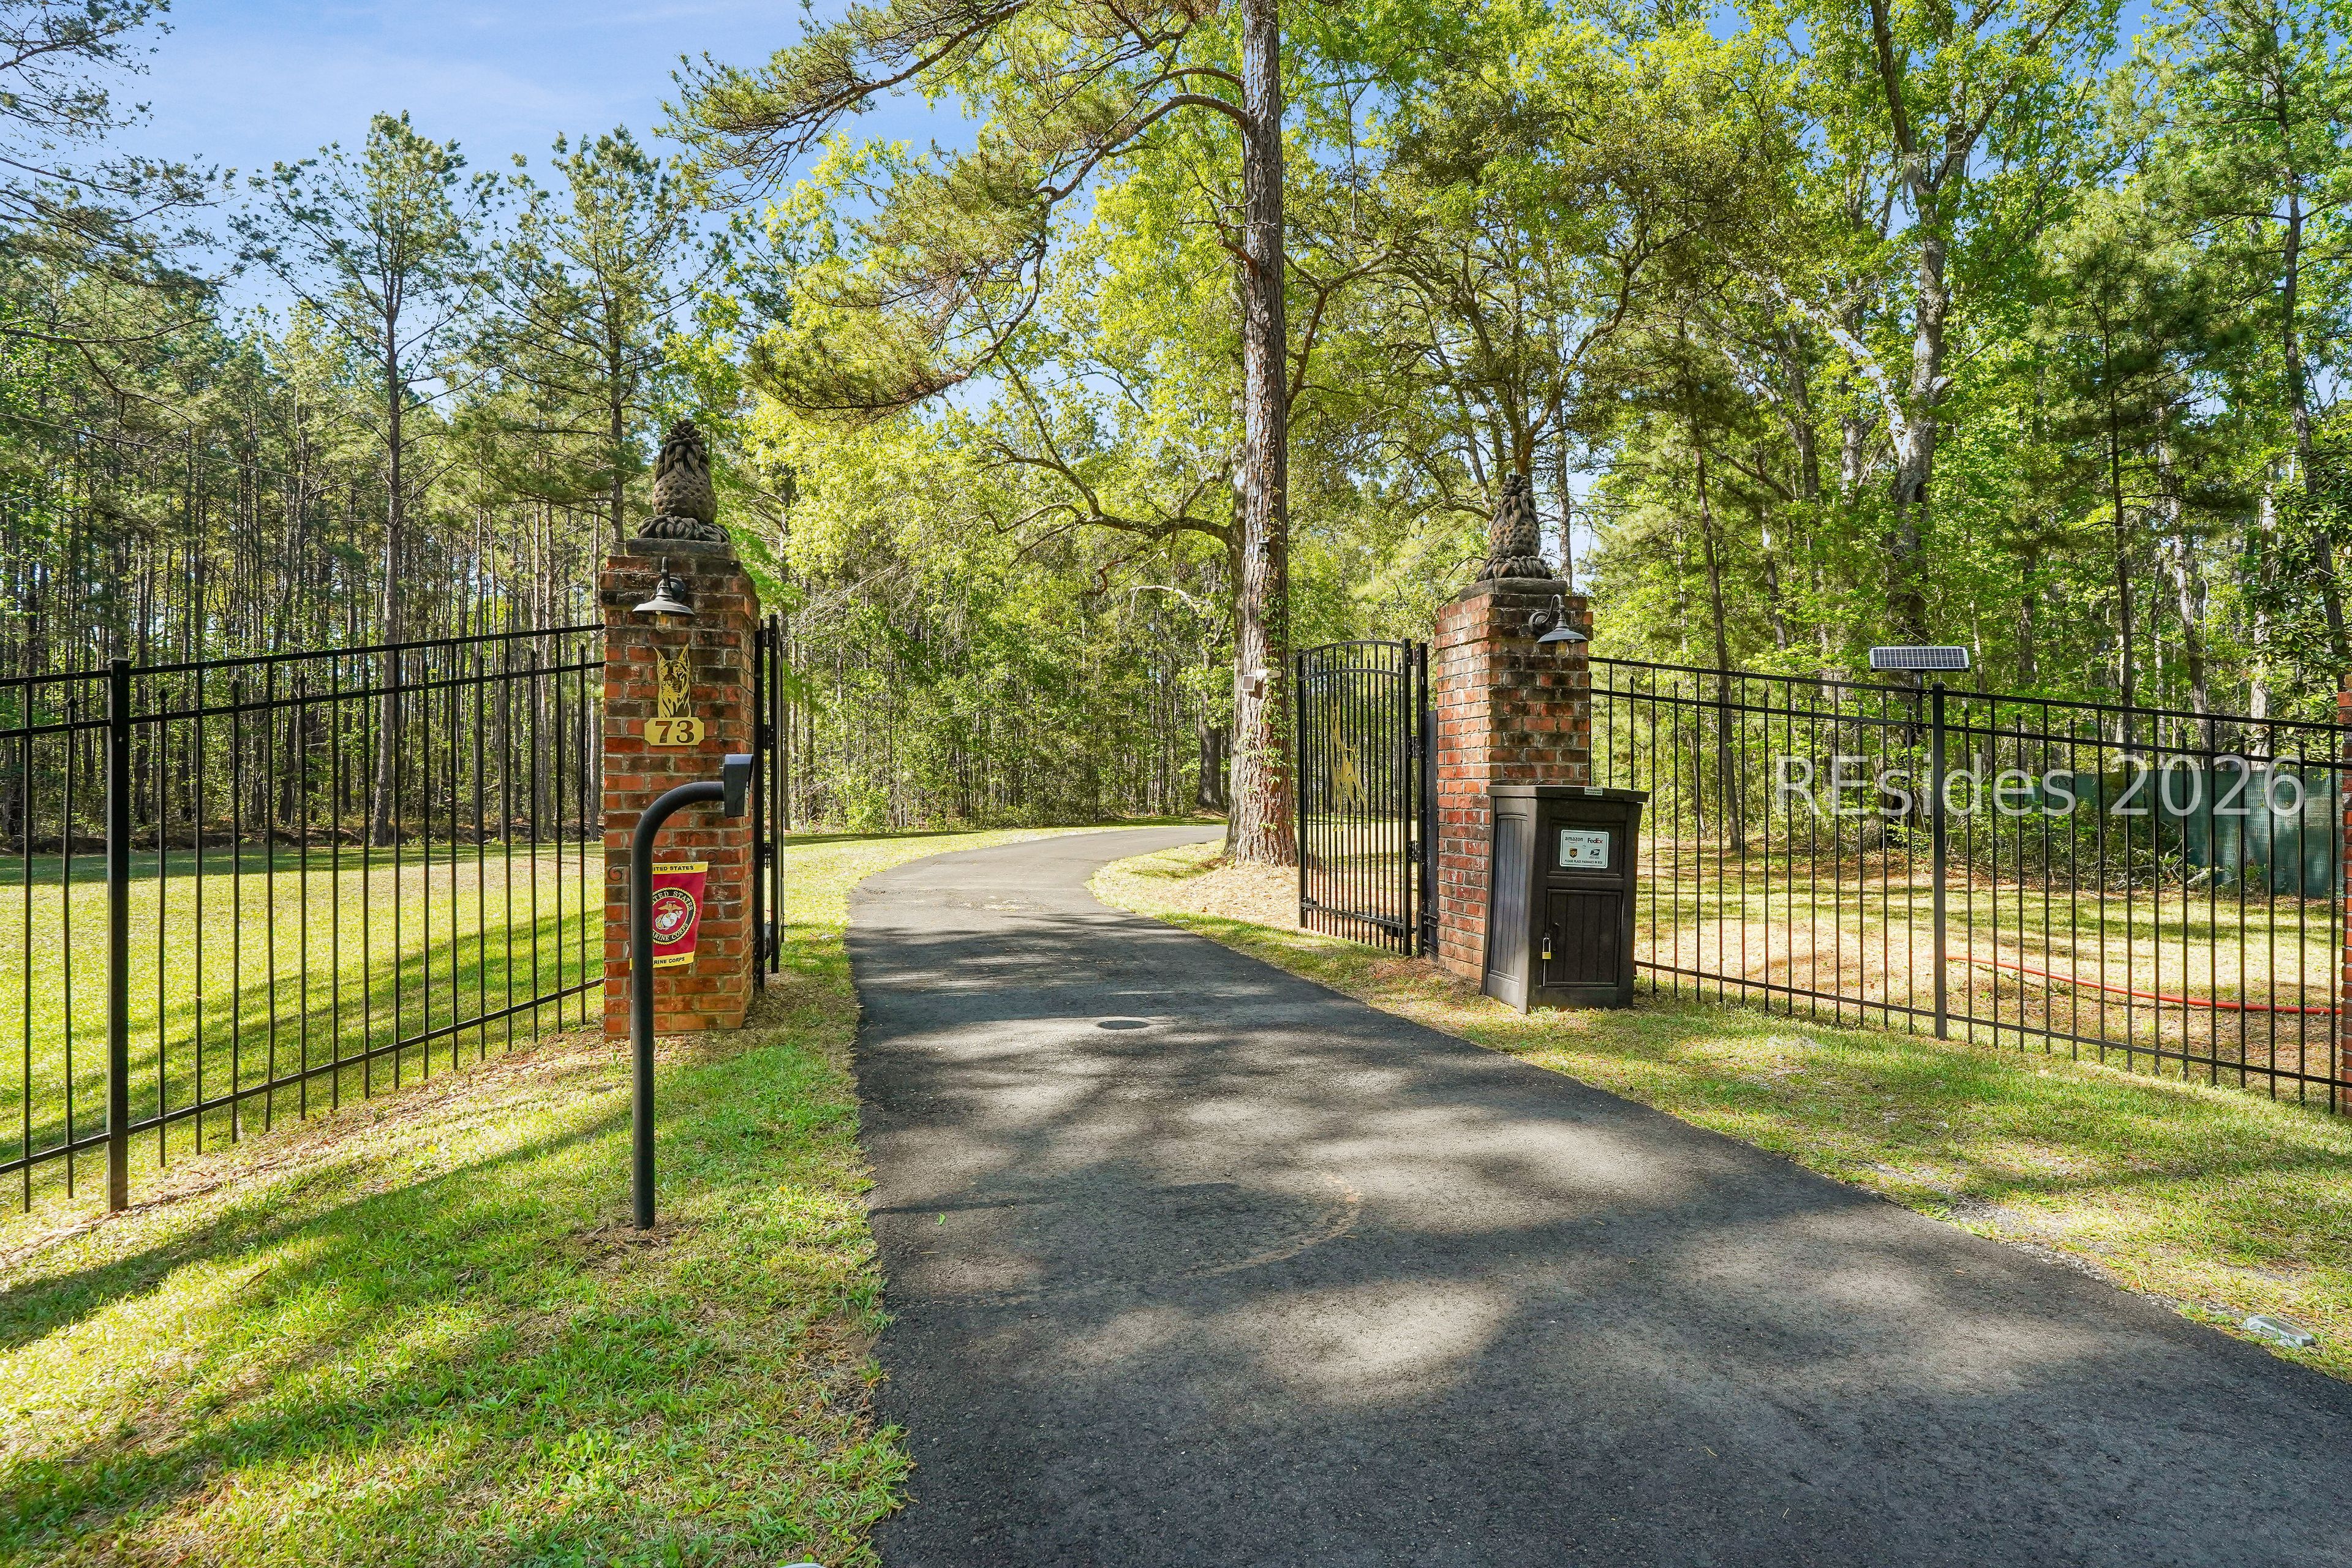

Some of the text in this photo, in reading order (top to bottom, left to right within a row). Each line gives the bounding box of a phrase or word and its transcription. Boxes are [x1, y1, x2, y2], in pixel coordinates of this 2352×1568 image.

[655, 720, 695, 743] 73
[673, 891, 693, 911] STATES
[652, 923, 688, 941] ARINE CORPS
